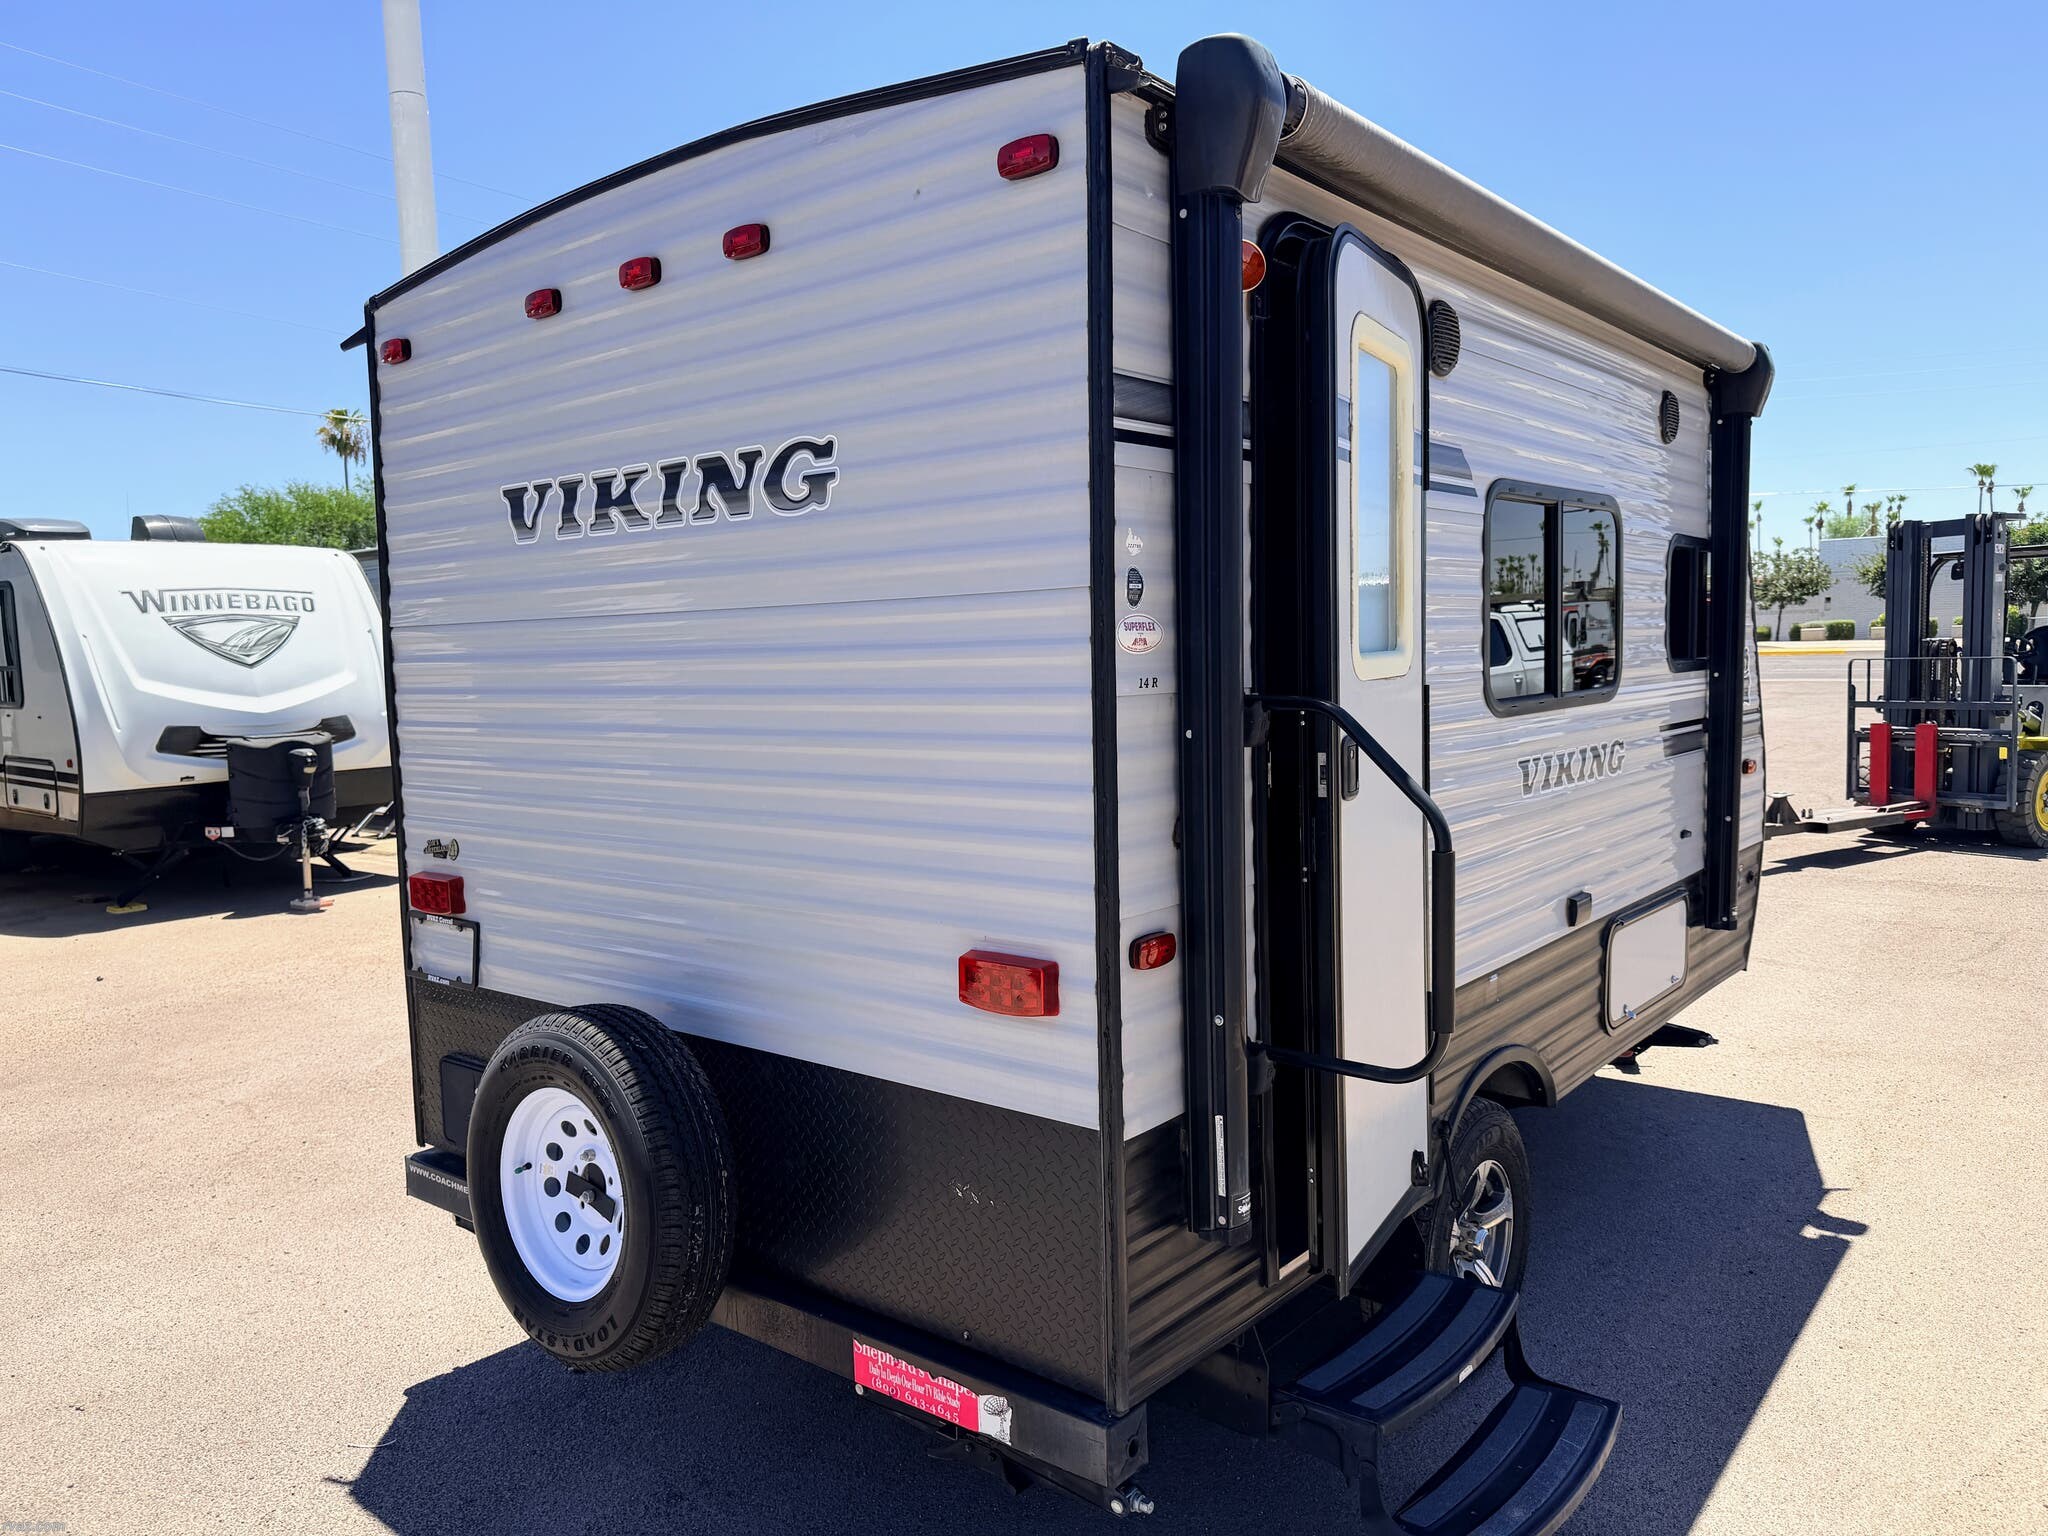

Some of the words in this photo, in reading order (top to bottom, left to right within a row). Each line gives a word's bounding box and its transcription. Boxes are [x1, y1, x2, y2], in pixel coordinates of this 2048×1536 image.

[500, 435, 840, 545] VIKING
[119, 587, 315, 613] WINNEBAGO
[1123, 621, 1156, 631] SUPERFLEX
[1138, 677, 1149, 689] 14
[1151, 677, 1159, 688] R
[1517, 739, 1625, 798] VIKING
[871, 1377, 900, 1399] (800)
[904, 1391, 959, 1423] 643-4645
